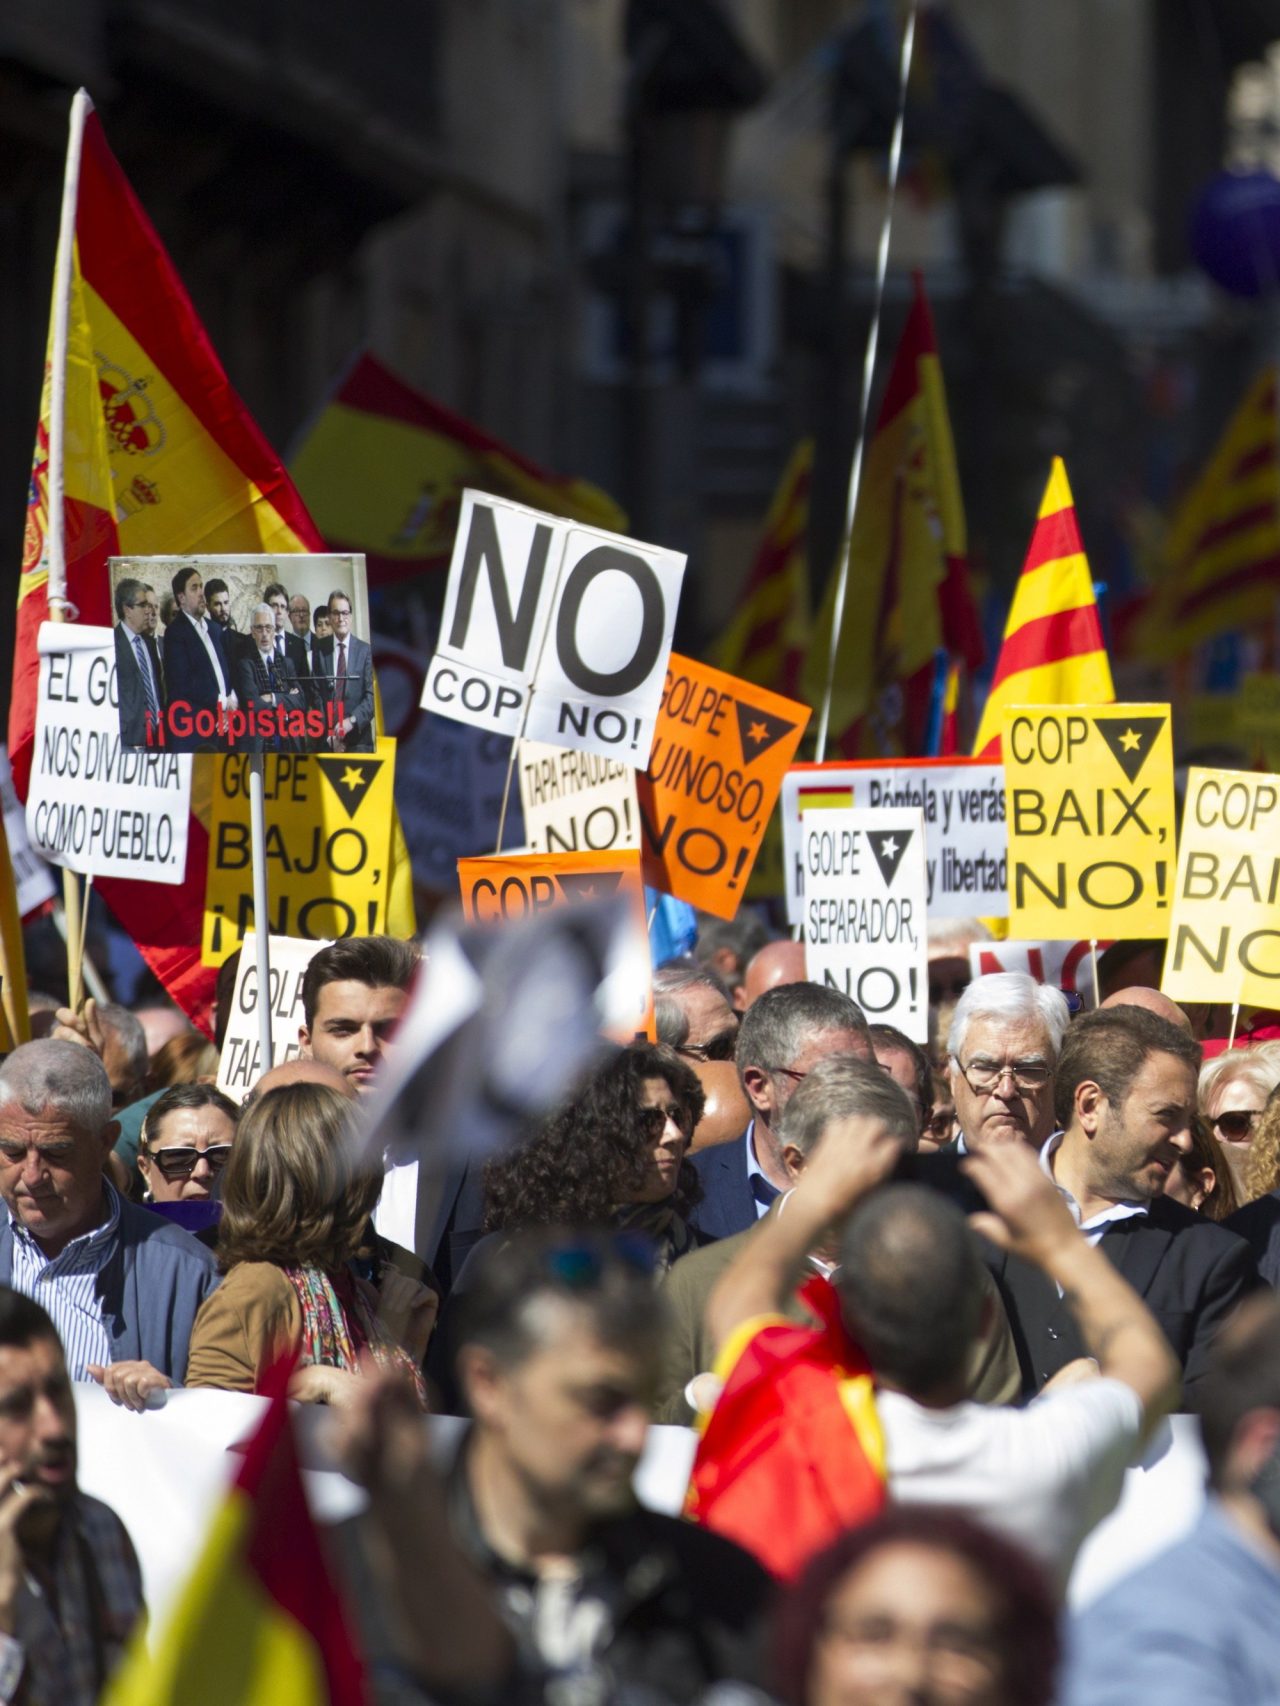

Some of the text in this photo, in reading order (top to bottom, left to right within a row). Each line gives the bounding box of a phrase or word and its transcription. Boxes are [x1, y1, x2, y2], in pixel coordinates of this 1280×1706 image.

[448, 503, 666, 698] NO
[47, 652, 78, 703] EL
[145, 699, 346, 748] ¡¡Golpistas!!
[433, 668, 643, 751] COP NO!
[41, 724, 82, 778] NOS
[1011, 715, 1090, 765] COP
[524, 756, 561, 807] TAPA
[647, 737, 765, 835] UINOSO,
[1194, 779, 1279, 832] COP
[35, 799, 177, 865] COMO PUEBLO.
[531, 798, 632, 853] NO!
[942, 789, 954, 835] y
[1012, 787, 1169, 844] BAIX,
[215, 821, 382, 886] BAJO,
[808, 831, 862, 876] GOLPE
[942, 847, 1008, 892] libertad
[471, 874, 556, 925] COP
[1014, 860, 1169, 910] NO!
[210, 893, 380, 954] ¡NO!
[808, 898, 918, 950] SEPARADOR,
[813, 966, 918, 1014] NO!
